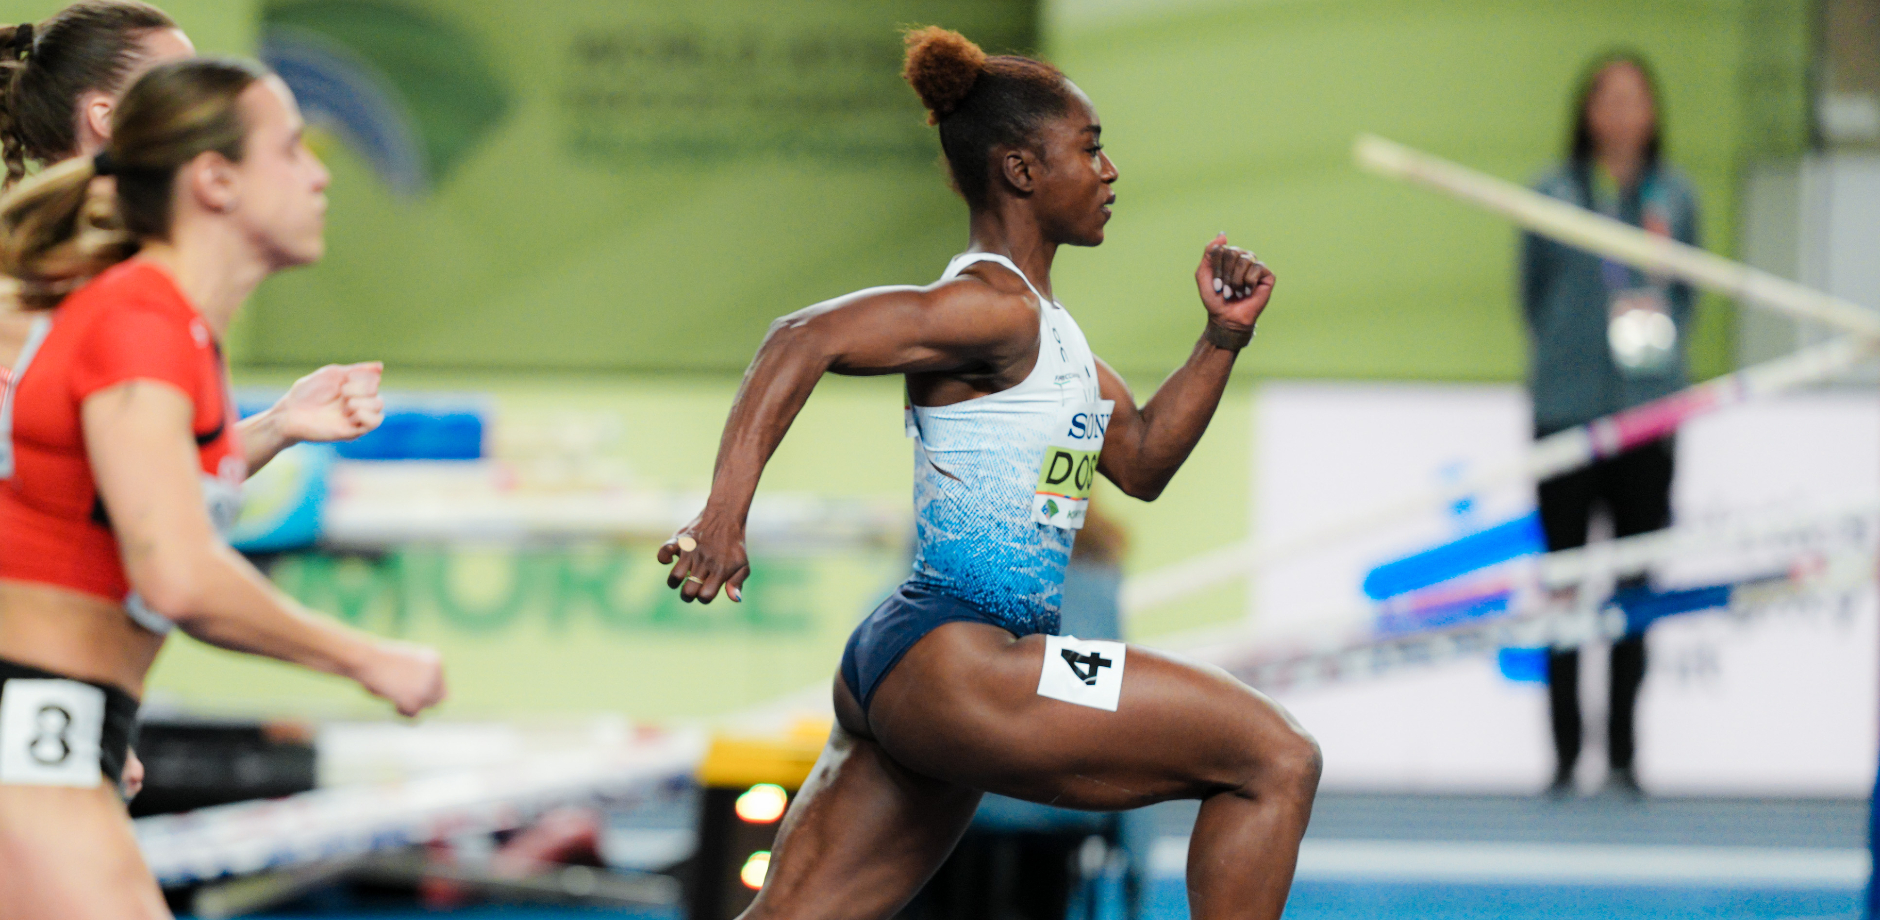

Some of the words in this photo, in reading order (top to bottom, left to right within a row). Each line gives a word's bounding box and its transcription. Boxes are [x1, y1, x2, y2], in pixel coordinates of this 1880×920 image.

[1067, 412, 1110, 440] SON
[1060, 648, 1112, 686] 4
[29, 704, 71, 766] 8
